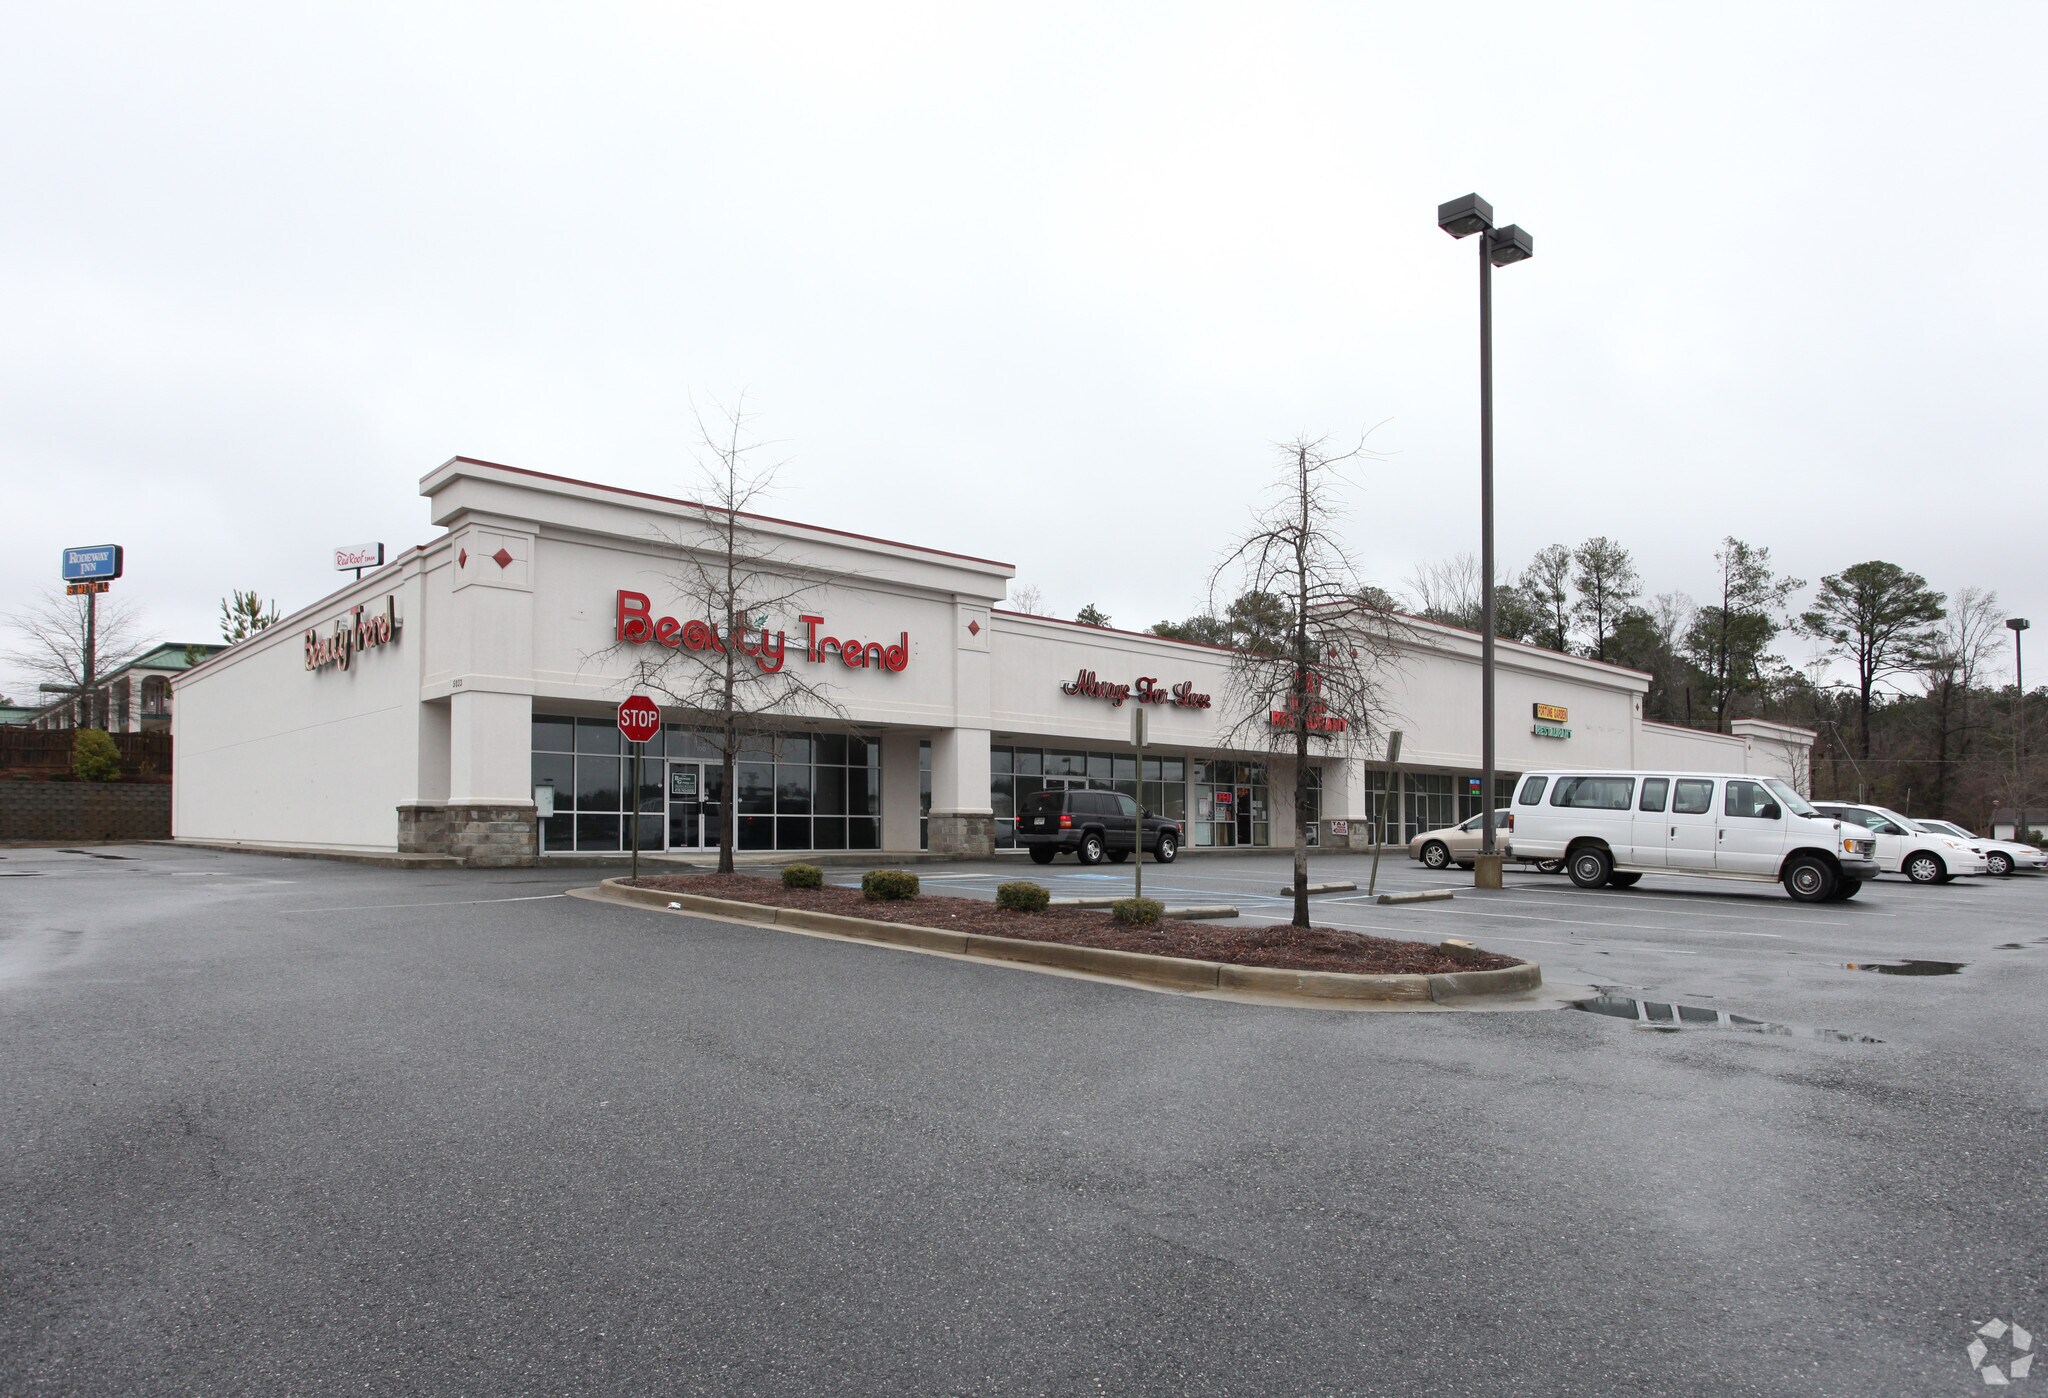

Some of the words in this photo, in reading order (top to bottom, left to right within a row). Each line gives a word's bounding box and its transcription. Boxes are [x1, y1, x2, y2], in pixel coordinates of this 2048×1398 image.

[69, 552, 109, 563] RODEWAY
[81, 563, 96, 574] INN
[305, 620, 351, 671] Beauty
[351, 595, 394, 652] Trend
[616, 590, 785, 673] Beauty
[799, 614, 908, 672] Trend
[1063, 669, 1131, 707] Always
[1135, 677, 1169, 704] For
[1173, 681, 1211, 708] Less
[621, 709, 658, 728] STOP
